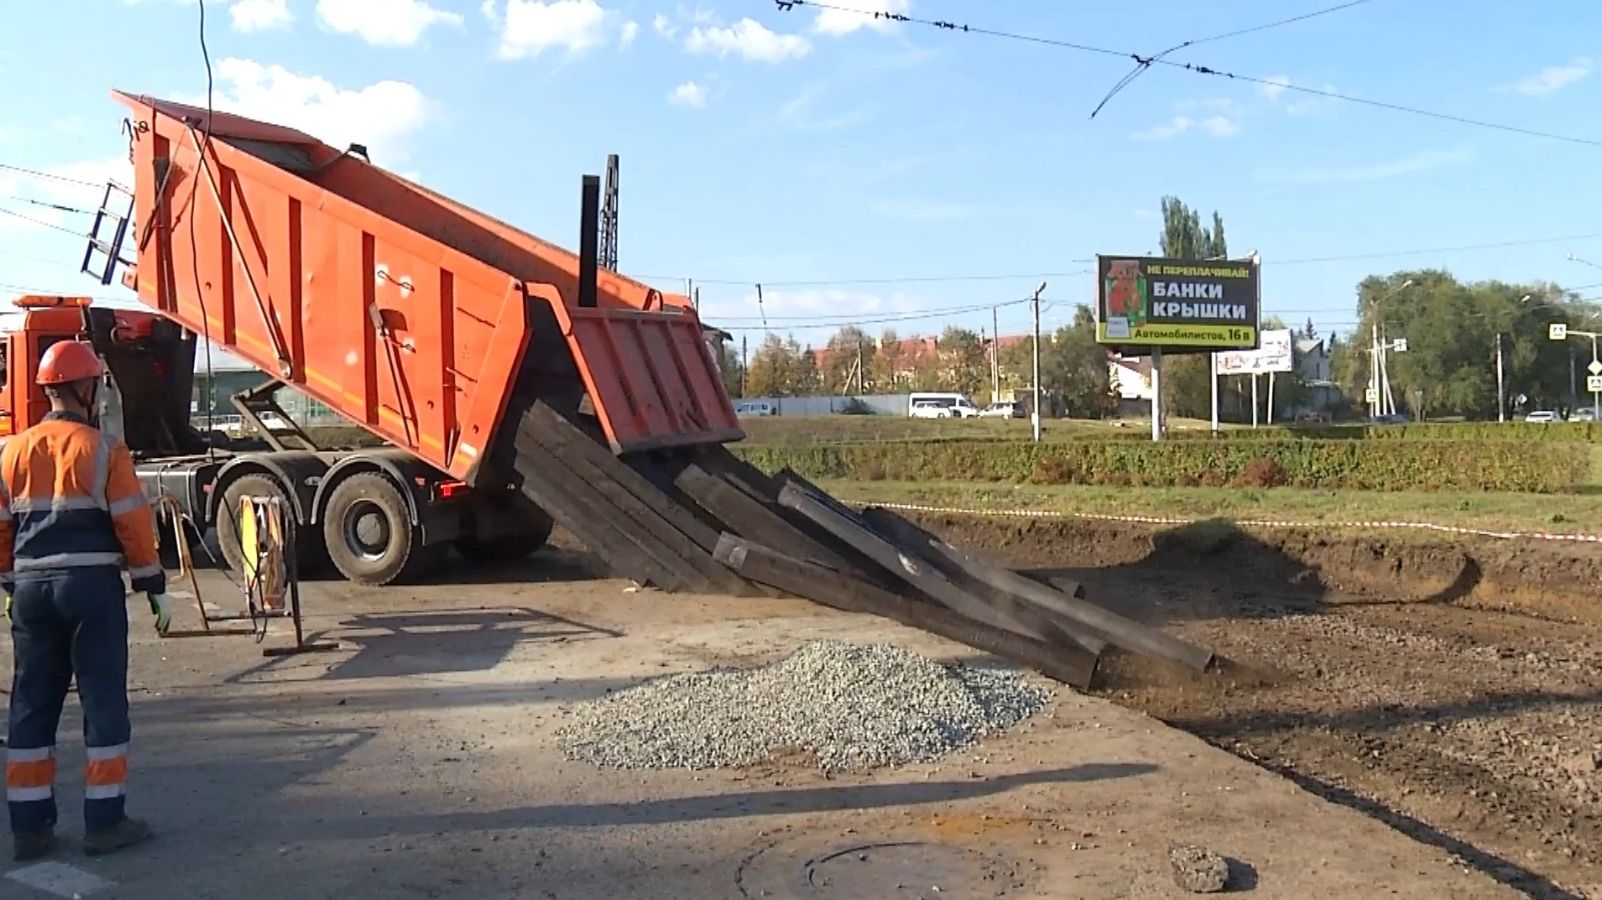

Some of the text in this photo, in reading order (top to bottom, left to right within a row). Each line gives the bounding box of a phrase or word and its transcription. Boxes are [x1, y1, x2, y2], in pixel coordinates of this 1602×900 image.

[1148, 265, 1249, 277] НЕ ПЕРЕПЛАЧИВАЙ!
[1153, 282, 1223, 299] БАНКИ
[1153, 302, 1246, 319] КРЫШКИ
[1134, 329, 1226, 341] Автомобилистов,
[1228, 329, 1241, 340] 16
